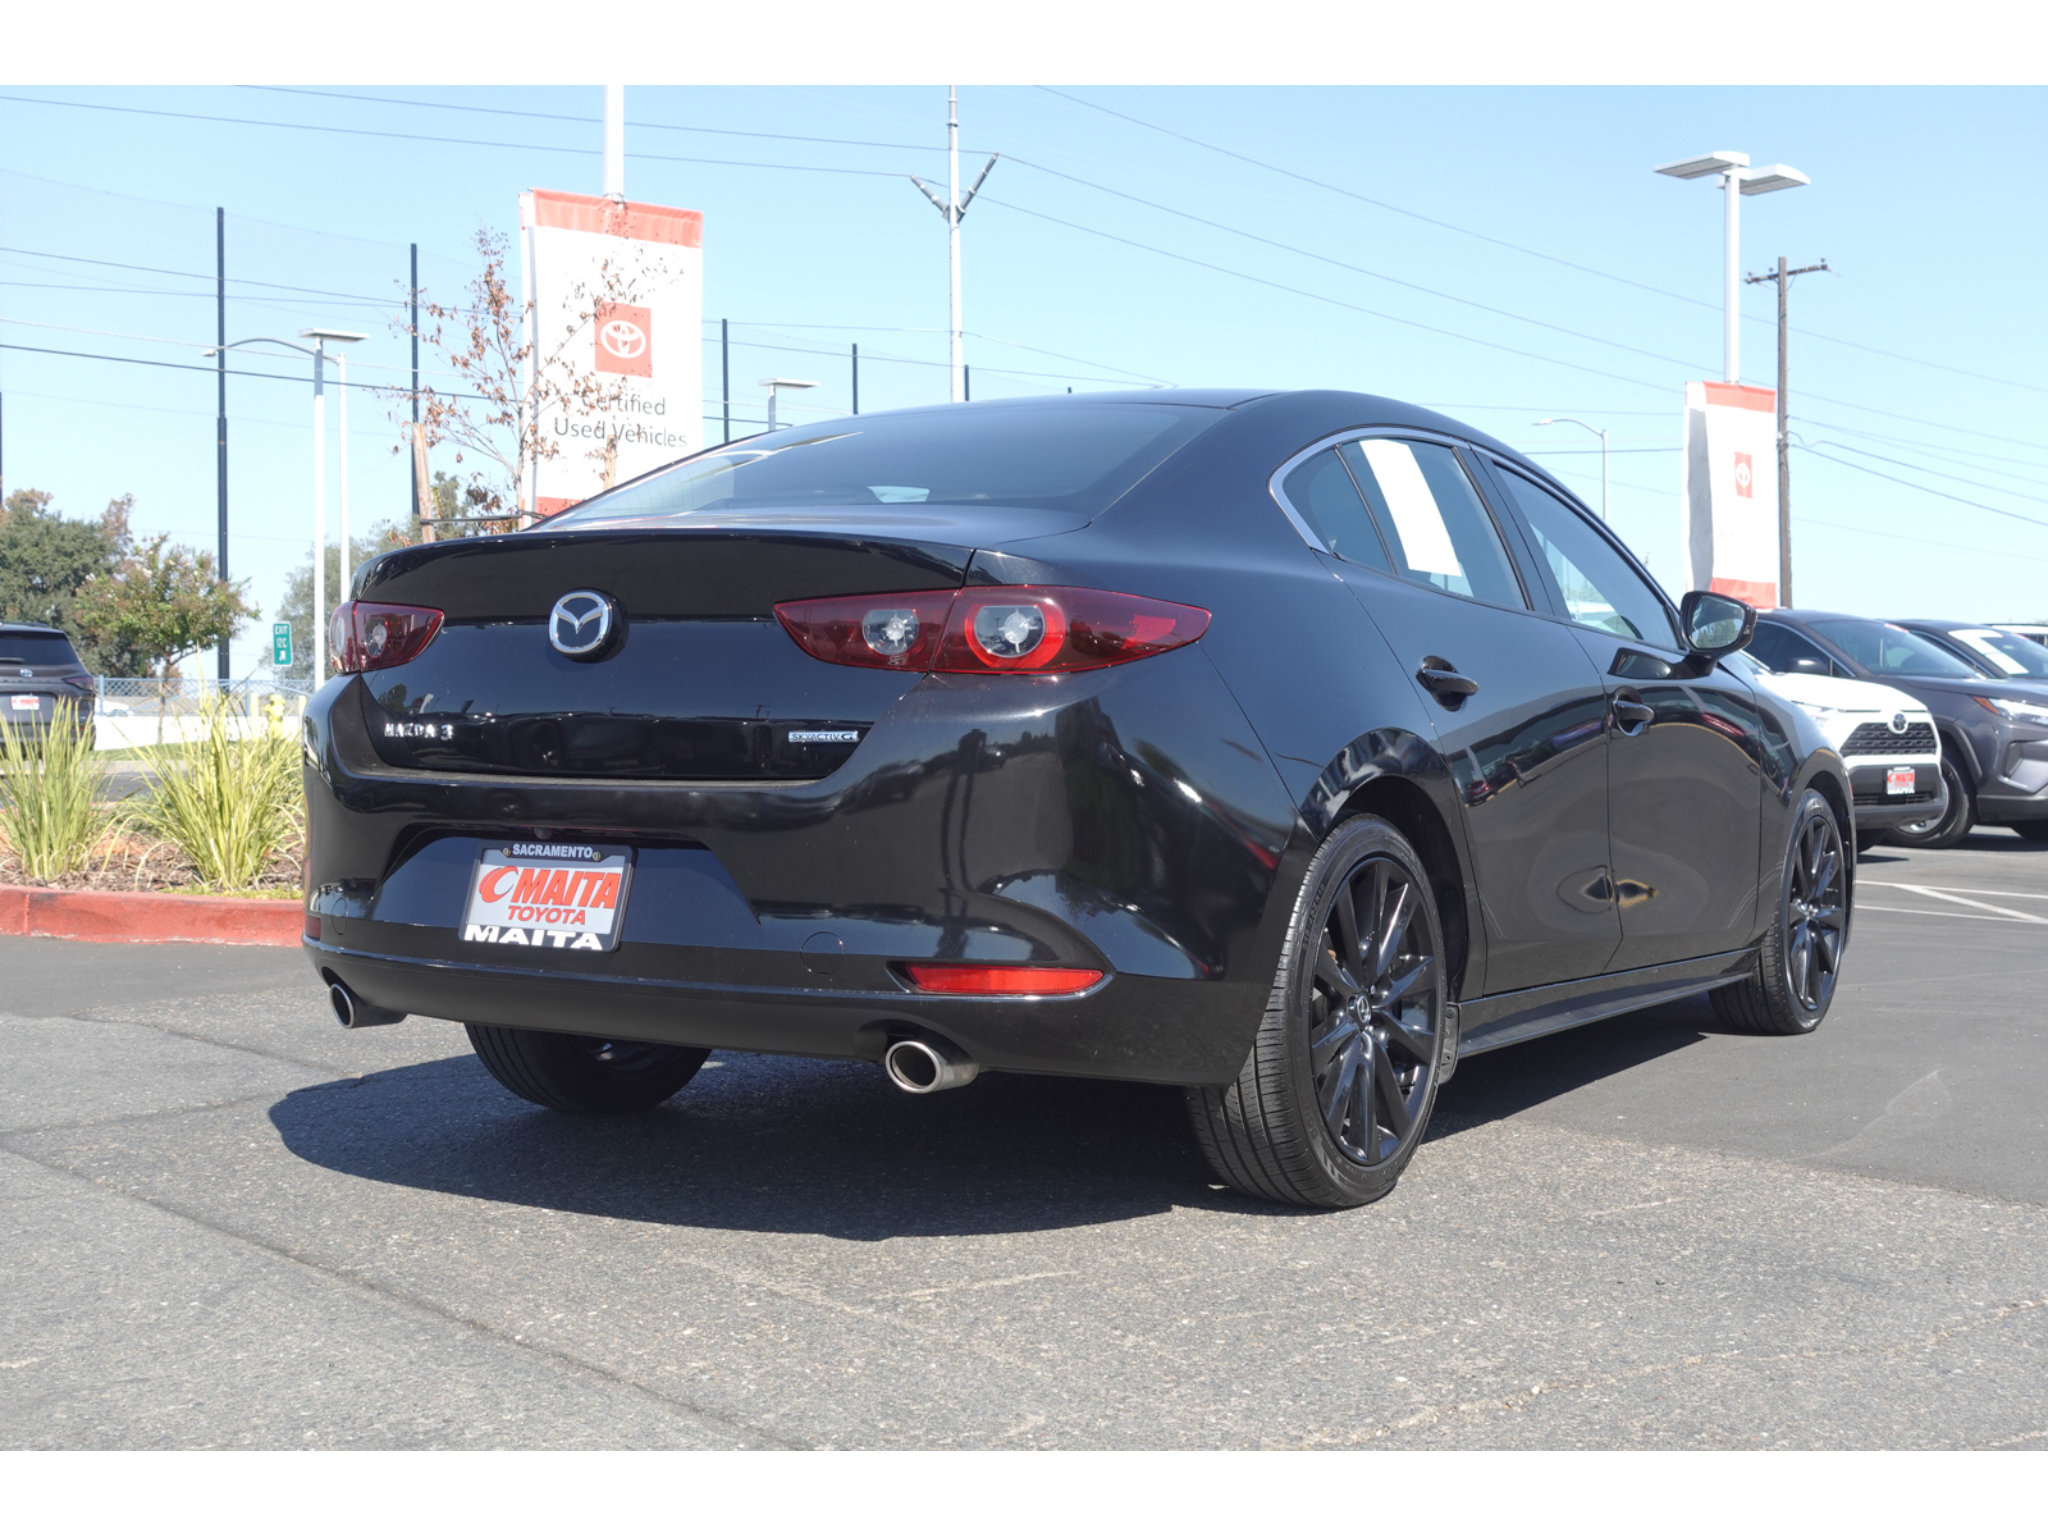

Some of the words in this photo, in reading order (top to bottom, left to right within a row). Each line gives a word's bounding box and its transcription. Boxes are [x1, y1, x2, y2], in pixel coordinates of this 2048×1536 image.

[554, 417, 605, 440] Used
[612, 422, 687, 447] Vehicles
[384, 722, 436, 738] MAZDA
[440, 724, 454, 740] 3
[512, 843, 593, 858] SACRAMENTO
[508, 905, 586, 925] TOYOTA
[464, 924, 603, 951] MAITA
